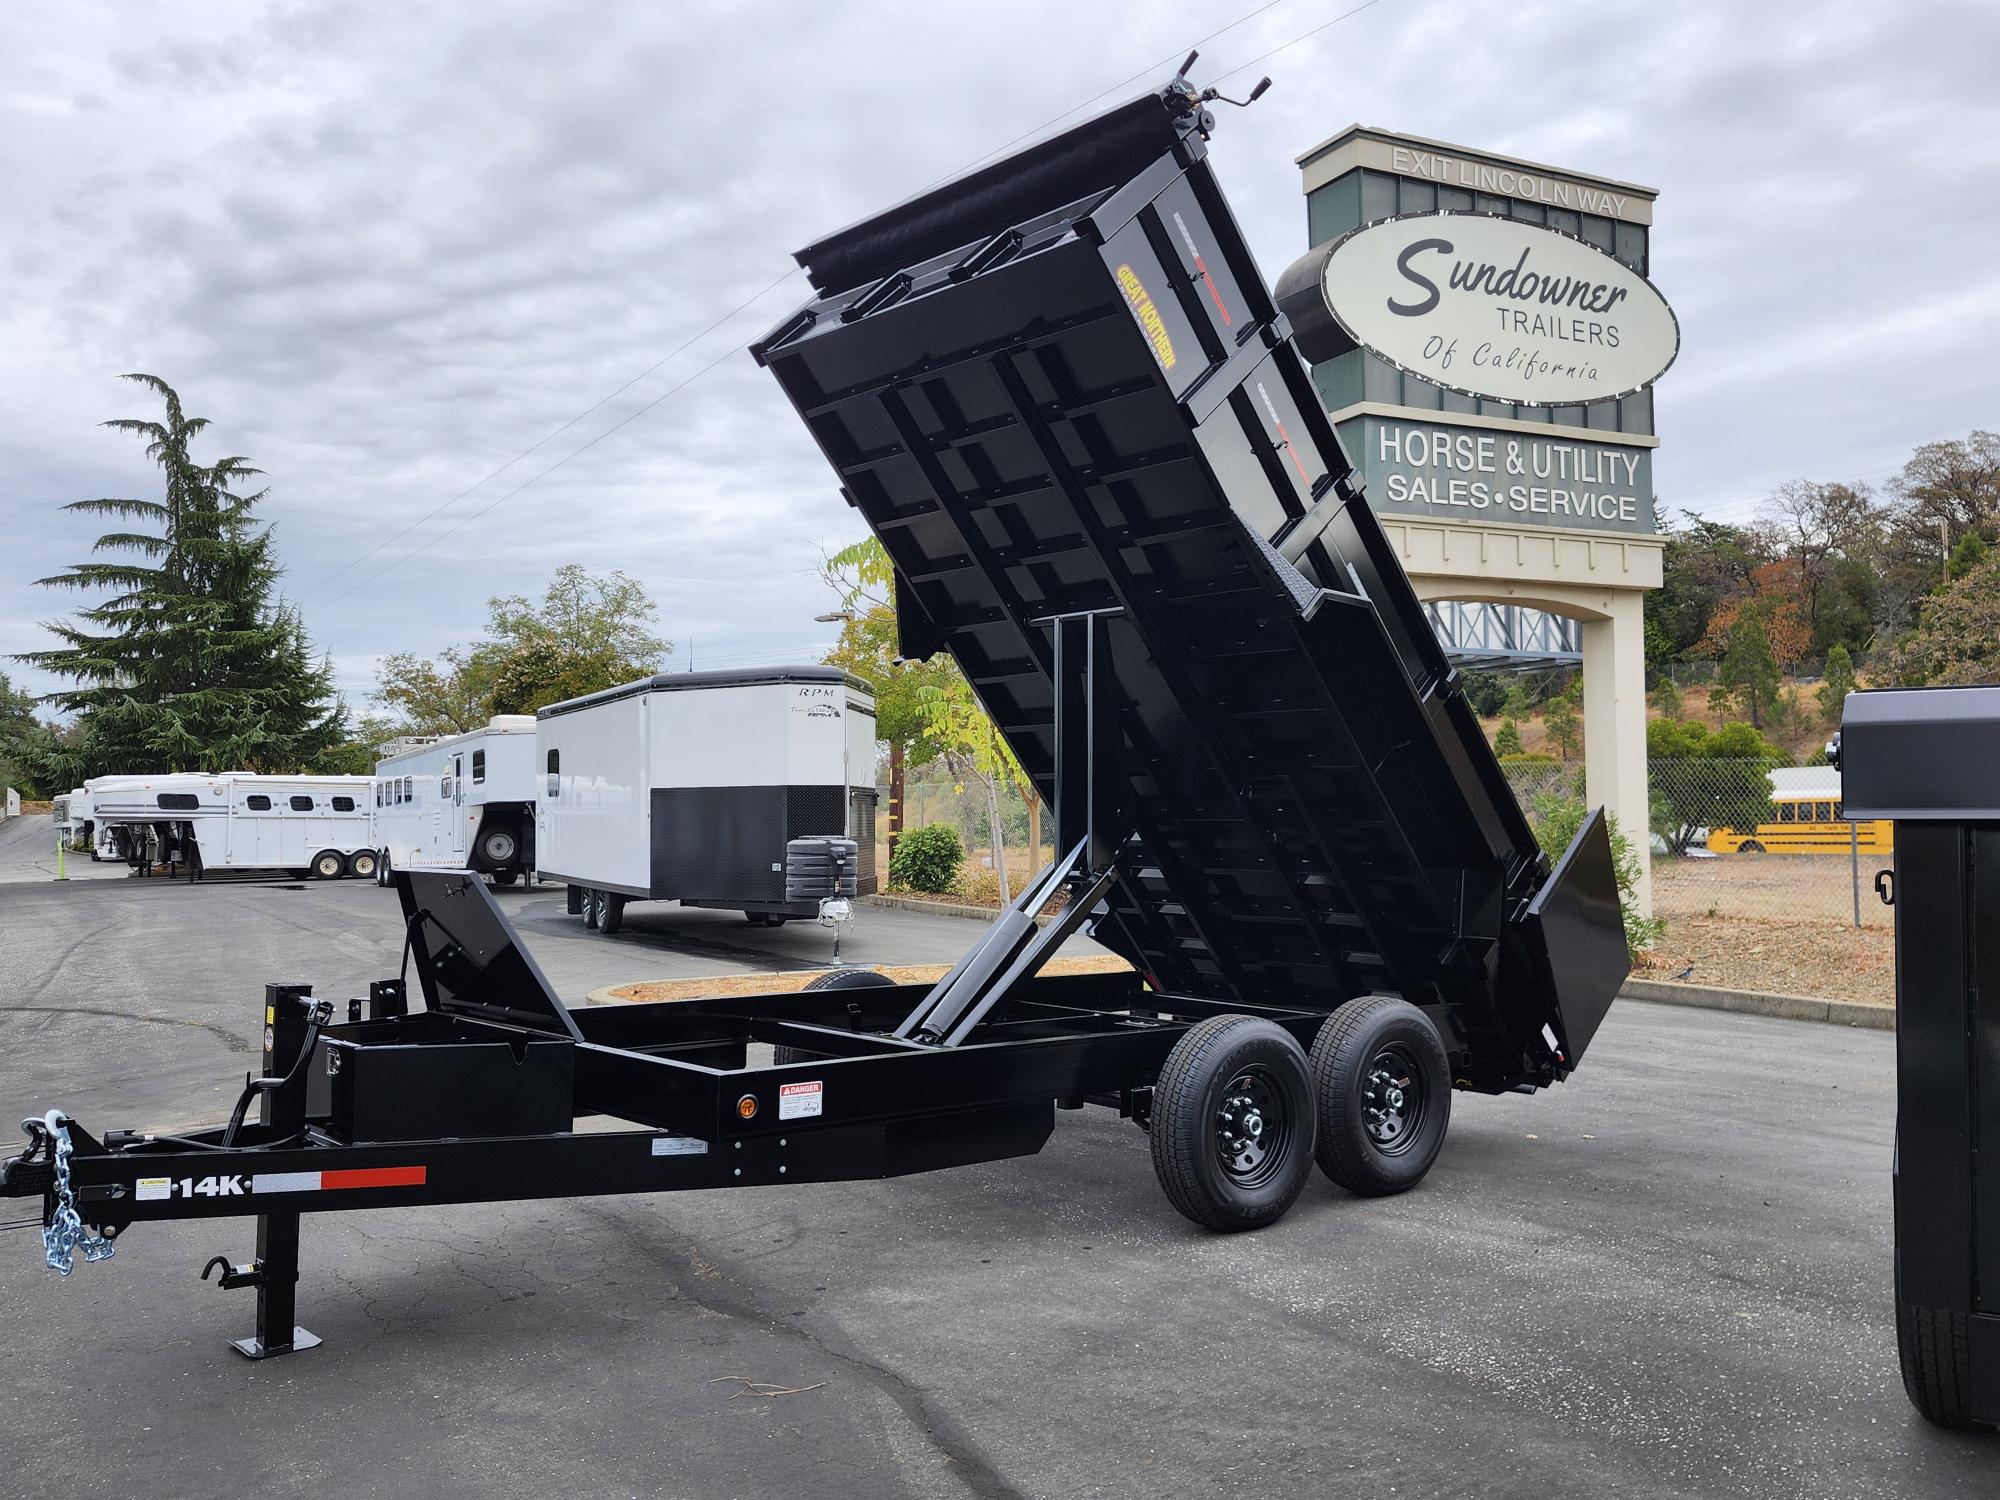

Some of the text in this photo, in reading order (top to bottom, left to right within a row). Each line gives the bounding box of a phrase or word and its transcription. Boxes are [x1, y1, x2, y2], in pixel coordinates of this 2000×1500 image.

[1392, 146, 1627, 217] EXIT LINCOLN WAY
[1387, 238, 1627, 317] Sundowner
[1118, 267, 1175, 368] GREAT NORTHERN
[1496, 307, 1620, 348] TRAILERS
[1423, 335, 1598, 381] Of California
[1379, 426, 1640, 487] HORSE & UTILITY
[799, 688, 834, 697] RPM
[790, 1084, 819, 1094] DANGER
[180, 1175, 244, 1198] 14K
